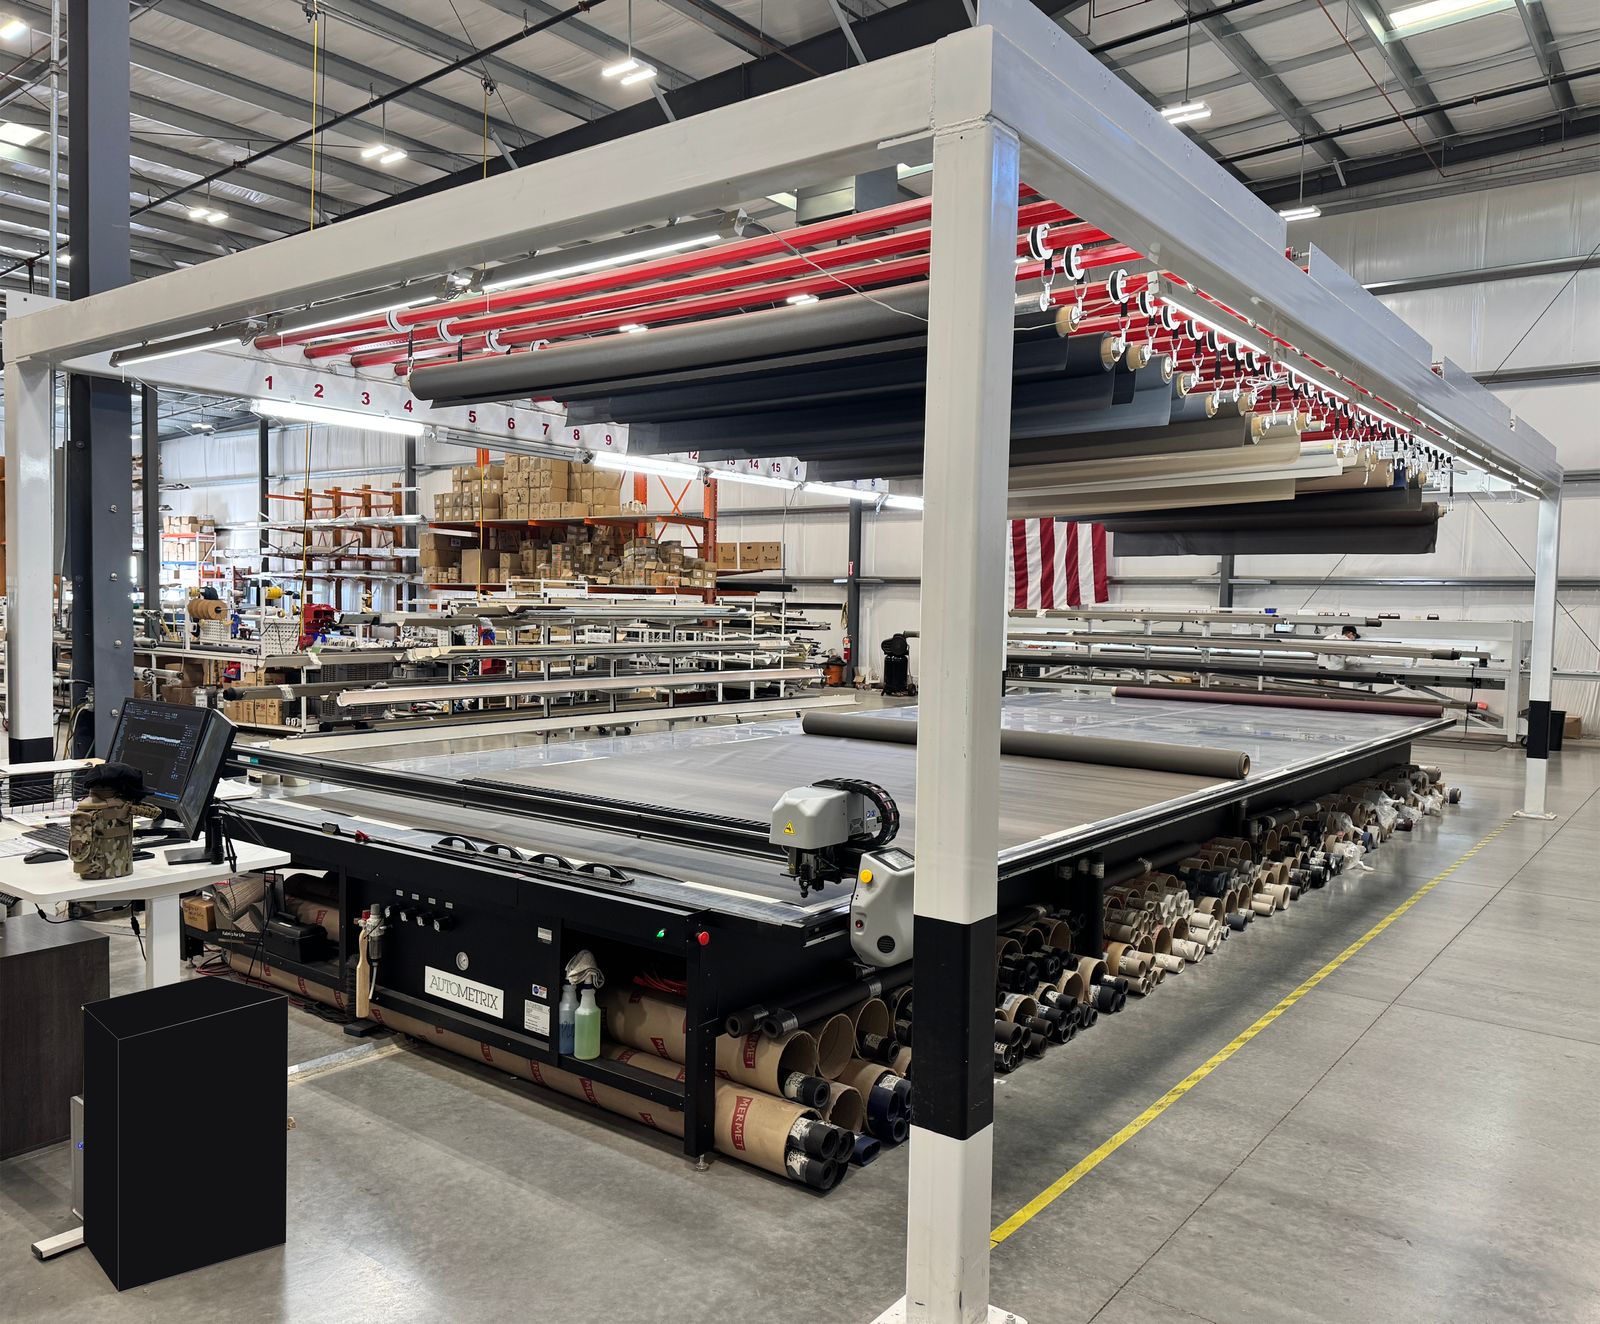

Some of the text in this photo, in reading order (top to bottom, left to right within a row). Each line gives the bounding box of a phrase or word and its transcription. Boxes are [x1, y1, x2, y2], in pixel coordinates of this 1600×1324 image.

[265, 375, 273, 390] 1
[314, 384, 324, 399] 2
[361, 392, 371, 406] 3
[404, 400, 413, 413] 4
[468, 410, 477, 424] 5
[507, 418, 515, 430] 6
[542, 423, 550, 435] 7
[573, 429, 580, 441] 8
[605, 434, 612, 446] 9
[688, 451, 698, 460] 12
[749, 459, 759, 470] 14
[771, 463, 781, 473] 15
[794, 466, 799, 476] 1
[429, 974, 498, 1011] AUTOMETRIX
[735, 1097, 751, 1151] MERMET
